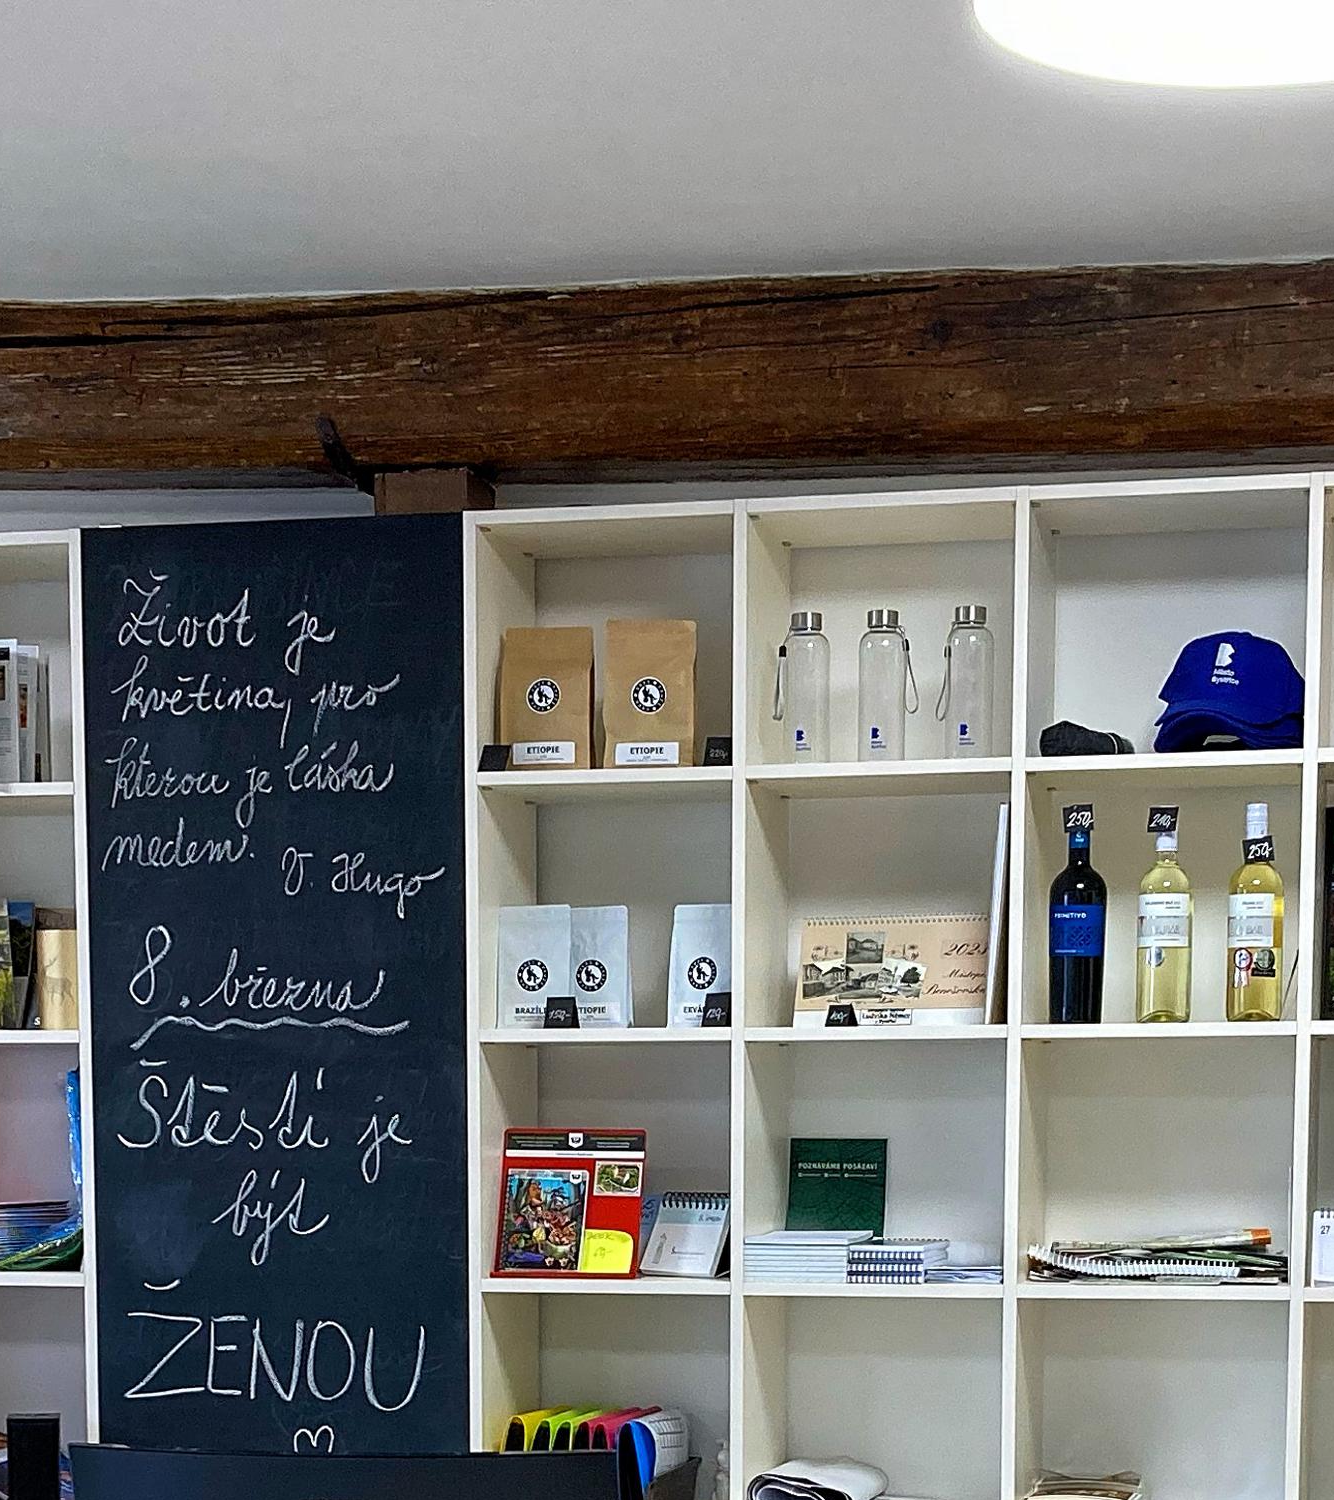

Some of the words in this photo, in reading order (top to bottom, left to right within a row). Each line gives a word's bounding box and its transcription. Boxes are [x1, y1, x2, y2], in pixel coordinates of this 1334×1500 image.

[118, 570, 255, 648] Život
[286, 594, 335, 675] je
[311, 674, 400, 738] pro
[105, 737, 230, 808] kterou
[235, 755, 272, 828] je
[284, 740, 394, 793] láska
[526, 745, 560, 755] ETIOPIE
[630, 746, 664, 756] ETIOPIE
[331, 852, 445, 919] Hugo
[128, 926, 190, 1008] 8.
[199, 948, 387, 1011] března
[515, 1004, 546, 1014] BRAZÍL
[578, 1005, 606, 1014] TIOPIE
[683, 1005, 705, 1014] EKVÁ
[117, 1059, 330, 1151] Štěstí
[357, 1094, 413, 1184] je
[213, 1169, 331, 1266] být
[125, 1278, 426, 1412] ŽENOU
